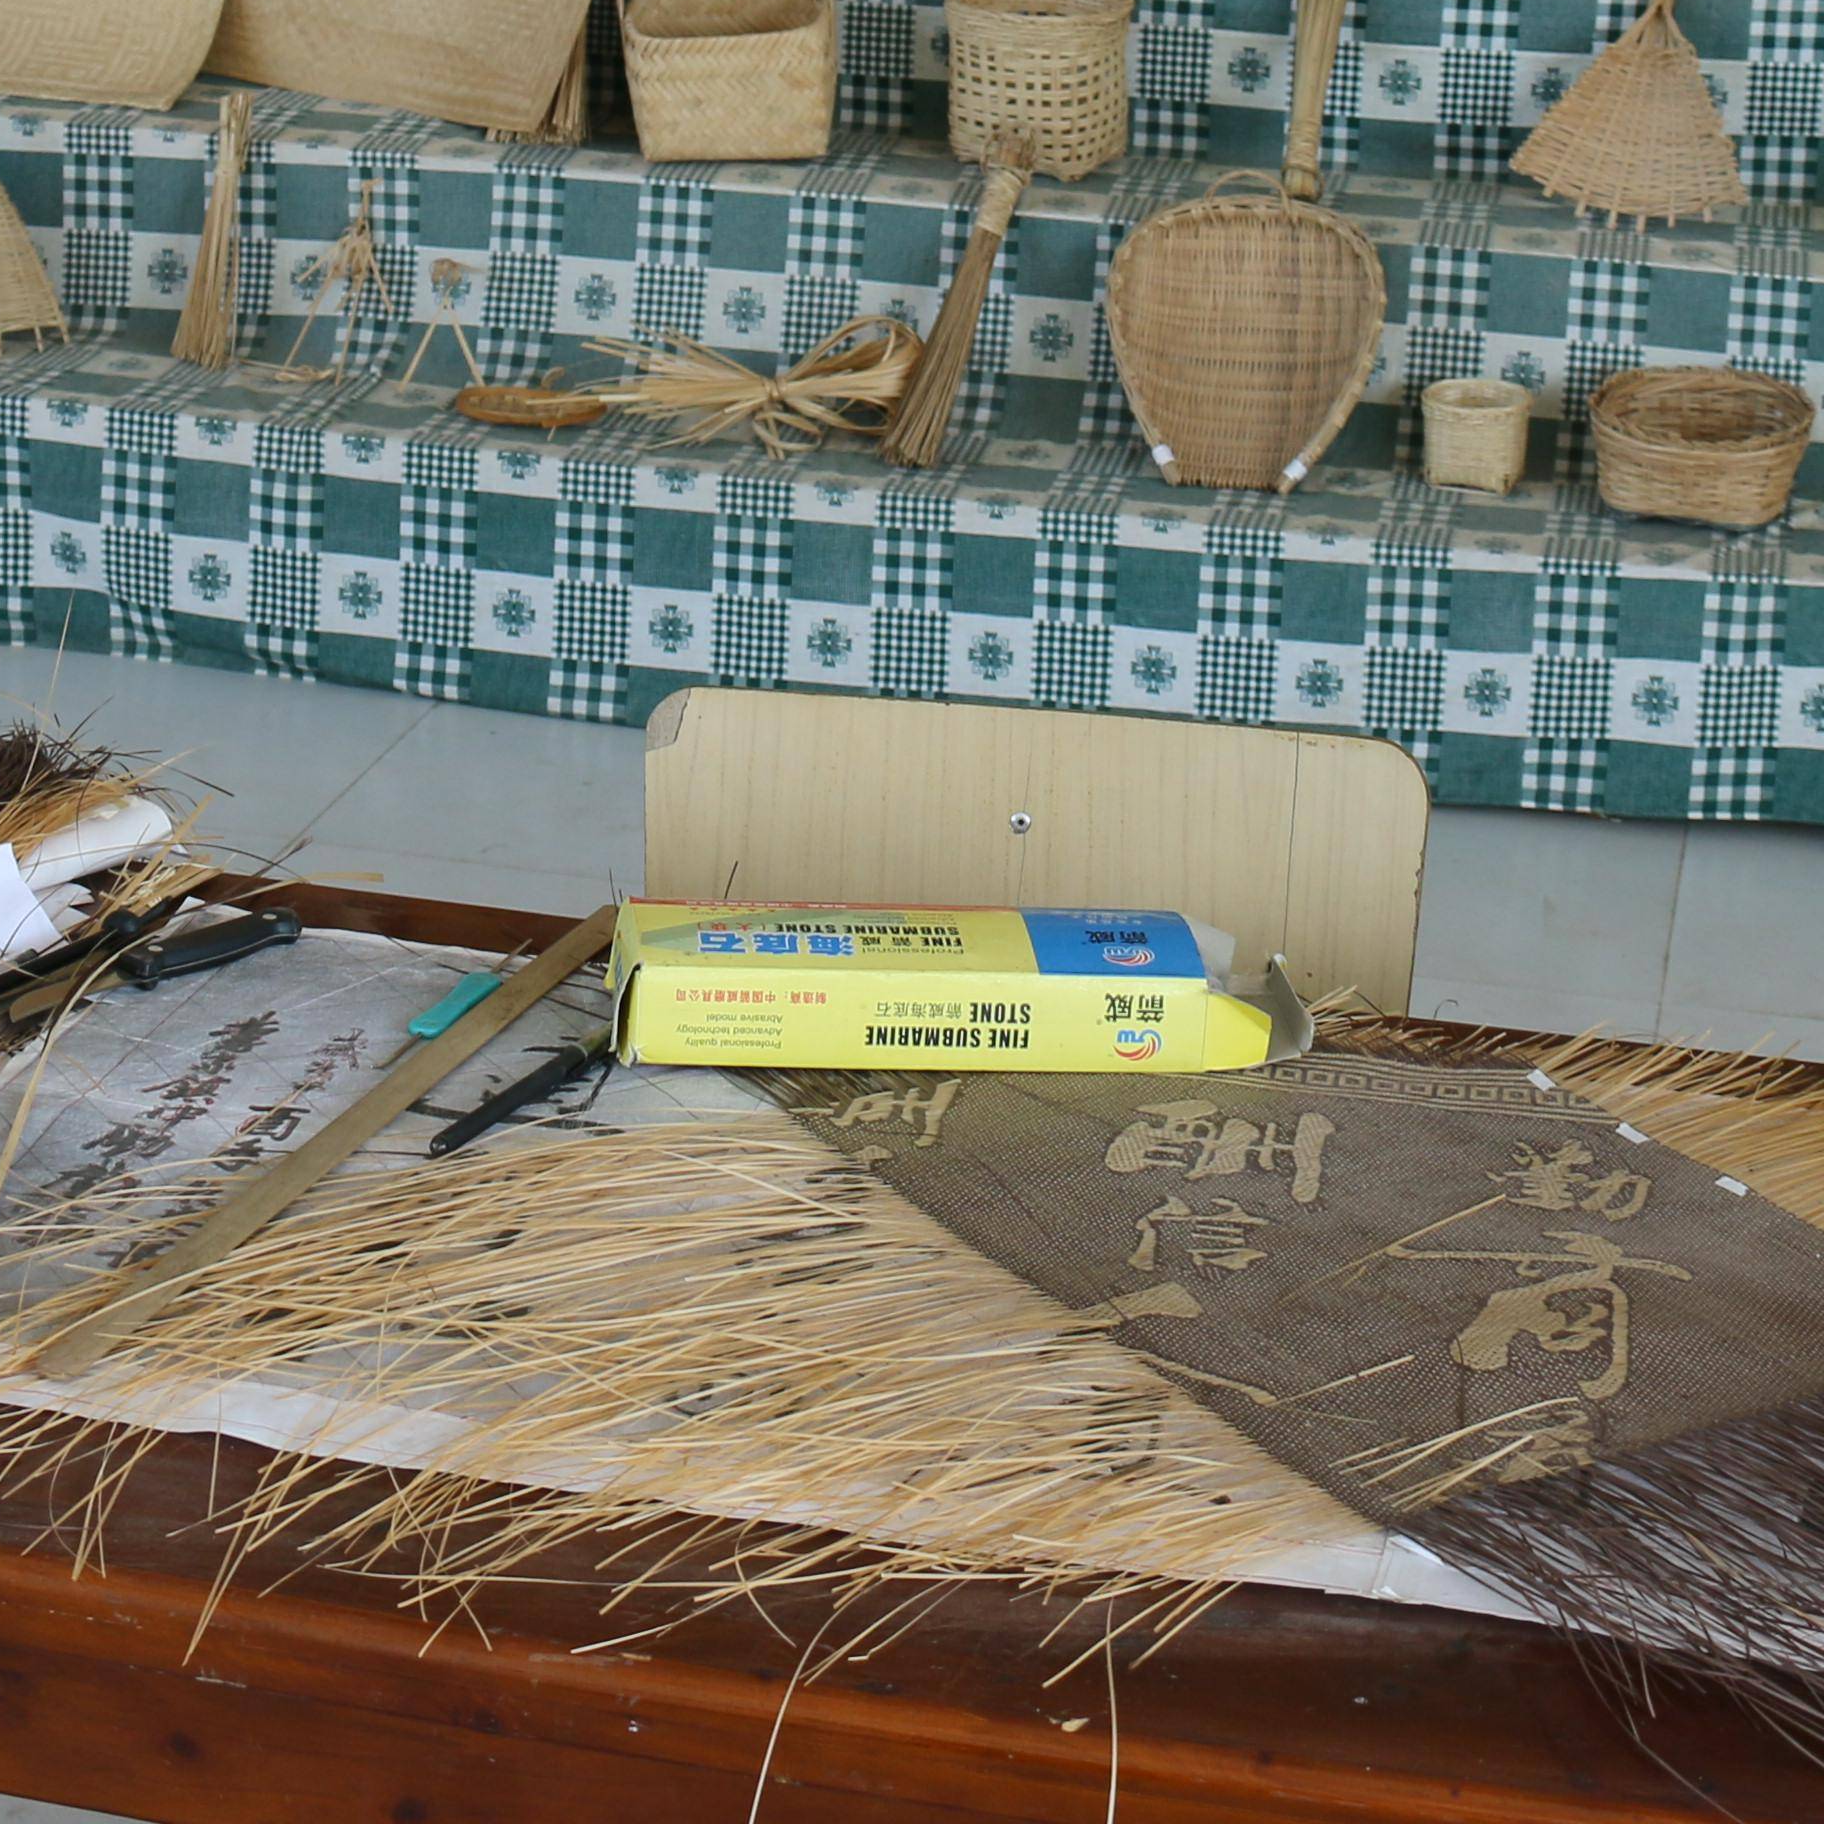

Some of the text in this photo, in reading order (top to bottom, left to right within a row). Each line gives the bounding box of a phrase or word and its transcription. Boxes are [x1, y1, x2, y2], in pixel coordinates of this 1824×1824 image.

[776, 923, 837, 934] STONE
[843, 925, 959, 936] SUBMARINE
[698, 932, 854, 956] 海底石
[919, 936, 962, 947] FINE
[875, 1001, 1032, 1024] STONE 箭威海底石
[1104, 993, 1165, 1023] 箭威
[706, 1013, 784, 1024] Abrasive model
[676, 1024, 783, 1037] Advanced technology
[685, 1037, 782, 1049] Professional quality
[864, 1026, 1030, 1049] FINE SUBMARINE
